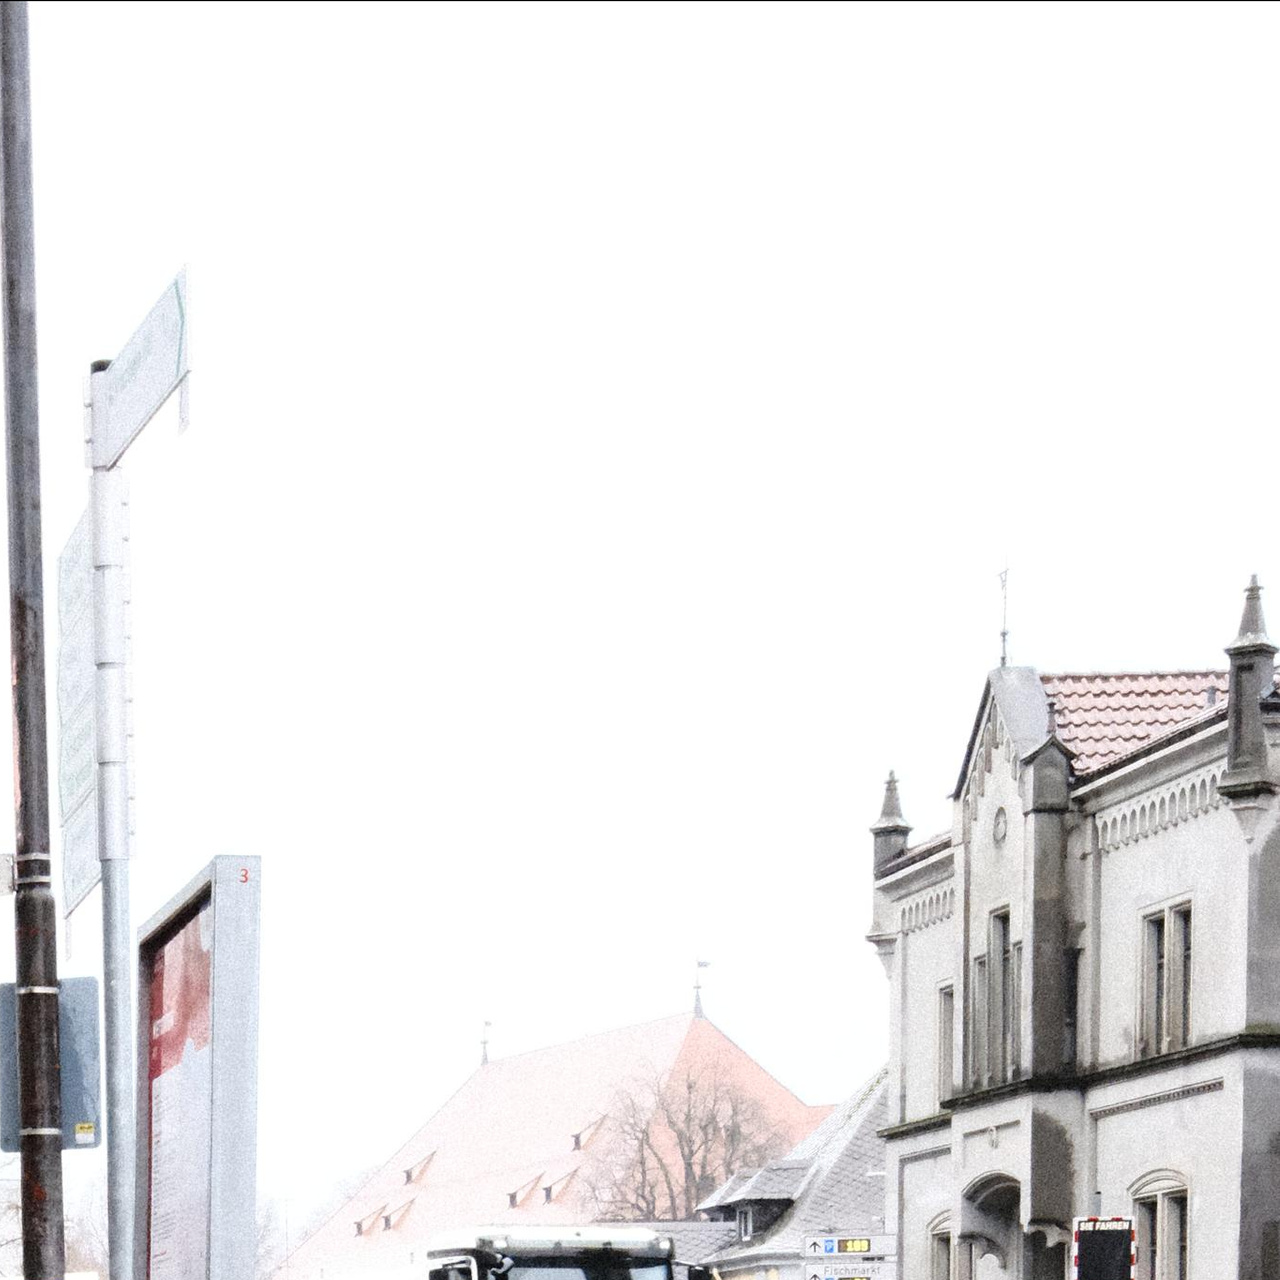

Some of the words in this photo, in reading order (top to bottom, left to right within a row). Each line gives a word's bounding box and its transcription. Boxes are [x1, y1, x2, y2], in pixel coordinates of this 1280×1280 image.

[239, 868, 249, 884] 3
[1079, 1221, 1093, 1231] SIE
[1095, 1221, 1130, 1231] FAHREN
[824, 1266, 881, 1276] Fischmarkt
